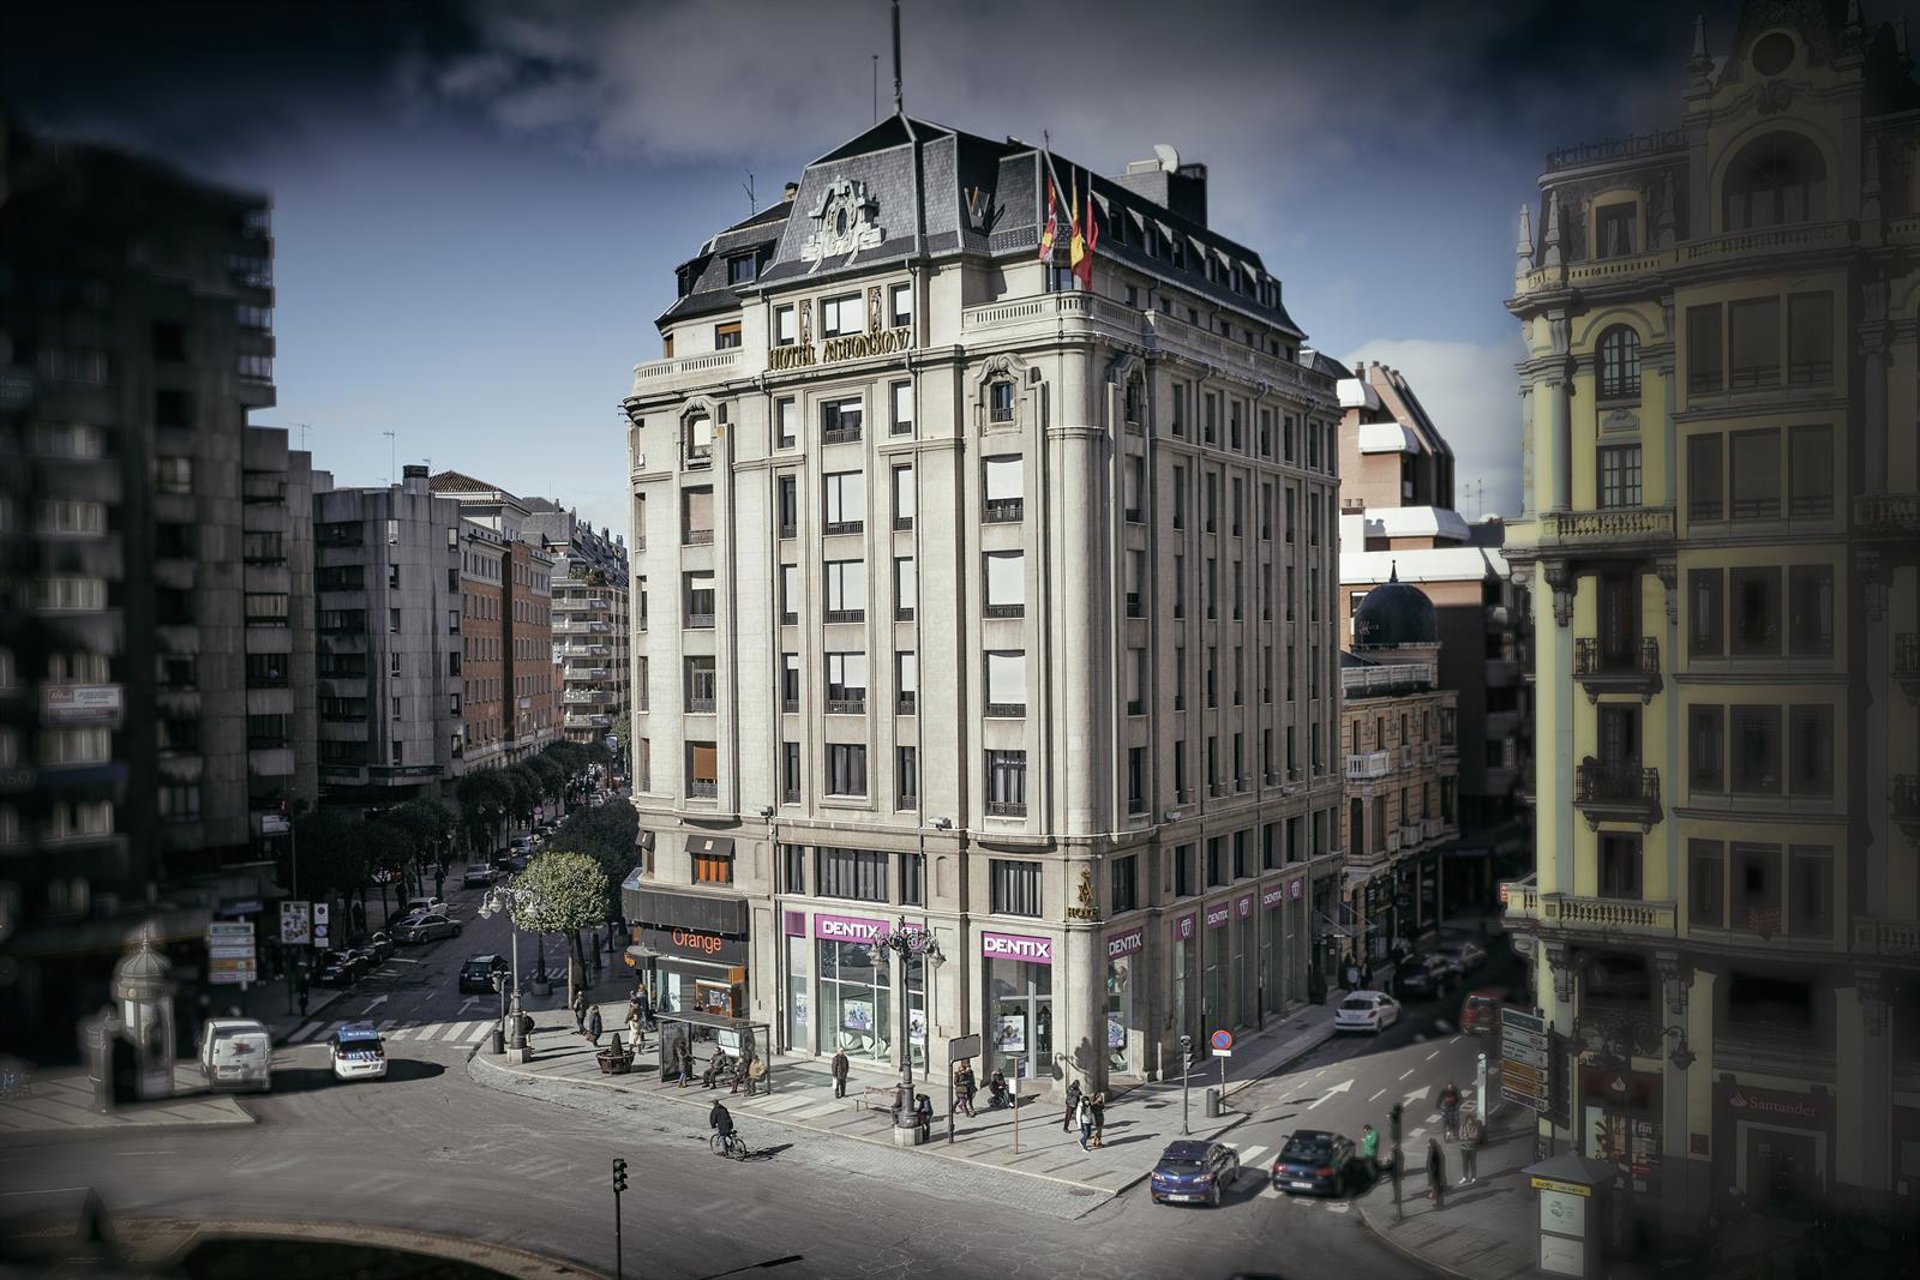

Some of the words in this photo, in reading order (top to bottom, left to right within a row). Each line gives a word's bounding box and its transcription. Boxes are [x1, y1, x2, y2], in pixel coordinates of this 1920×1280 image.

[768, 343, 816, 371] HOTEL
[1263, 891, 1282, 905] DENTIX
[1207, 909, 1230, 925] DENTIX
[822, 920, 880, 940] DENTIX
[672, 928, 722, 954] Orange
[983, 937, 1050, 958] DENTIX
[1108, 933, 1142, 956] DENTIX
[1748, 1095, 1819, 1117] Santander
